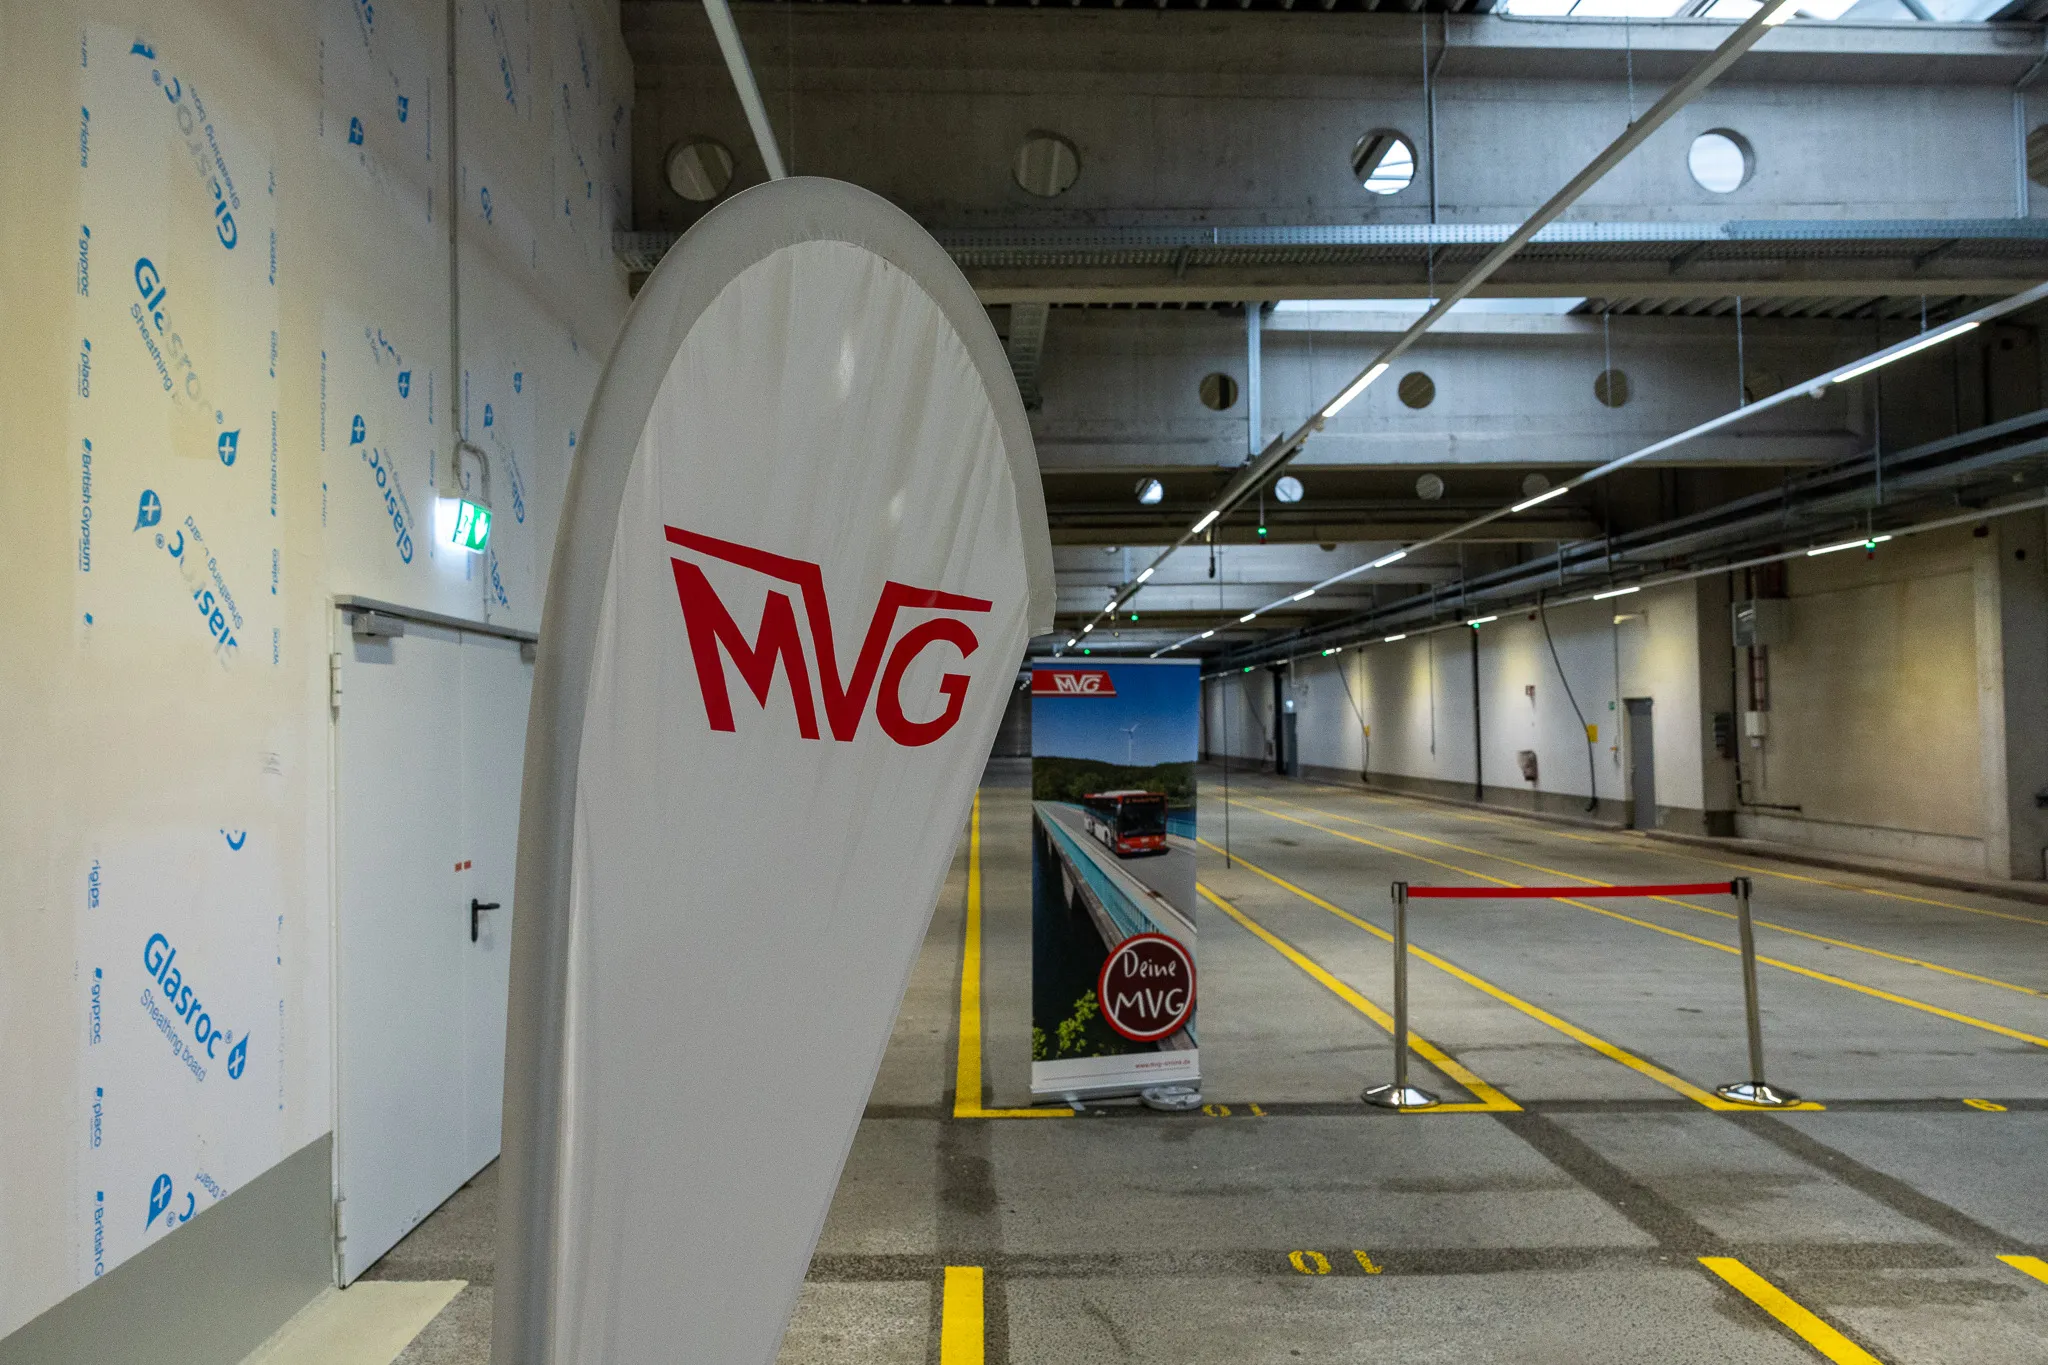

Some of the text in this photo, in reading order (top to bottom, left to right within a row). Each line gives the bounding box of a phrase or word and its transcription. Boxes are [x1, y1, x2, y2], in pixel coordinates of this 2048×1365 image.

[79, 238, 90, 298] gyproc
[130, 302, 173, 391] Sheathing
[79, 352, 91, 399] placo
[81, 451, 93, 503] British
[81, 503, 93, 573] Gypsum
[664, 524, 993, 748] MVG
[1053, 674, 1103, 694] MVG
[91, 859, 102, 910] rigips
[1123, 949, 1177, 978] Deine
[91, 984, 102, 1044] gyproc
[1113, 988, 1185, 1020] MVG
[140, 988, 207, 1082] Sheathing board
[92, 1102, 103, 1148] placo
[94, 1207, 105, 1259] British
